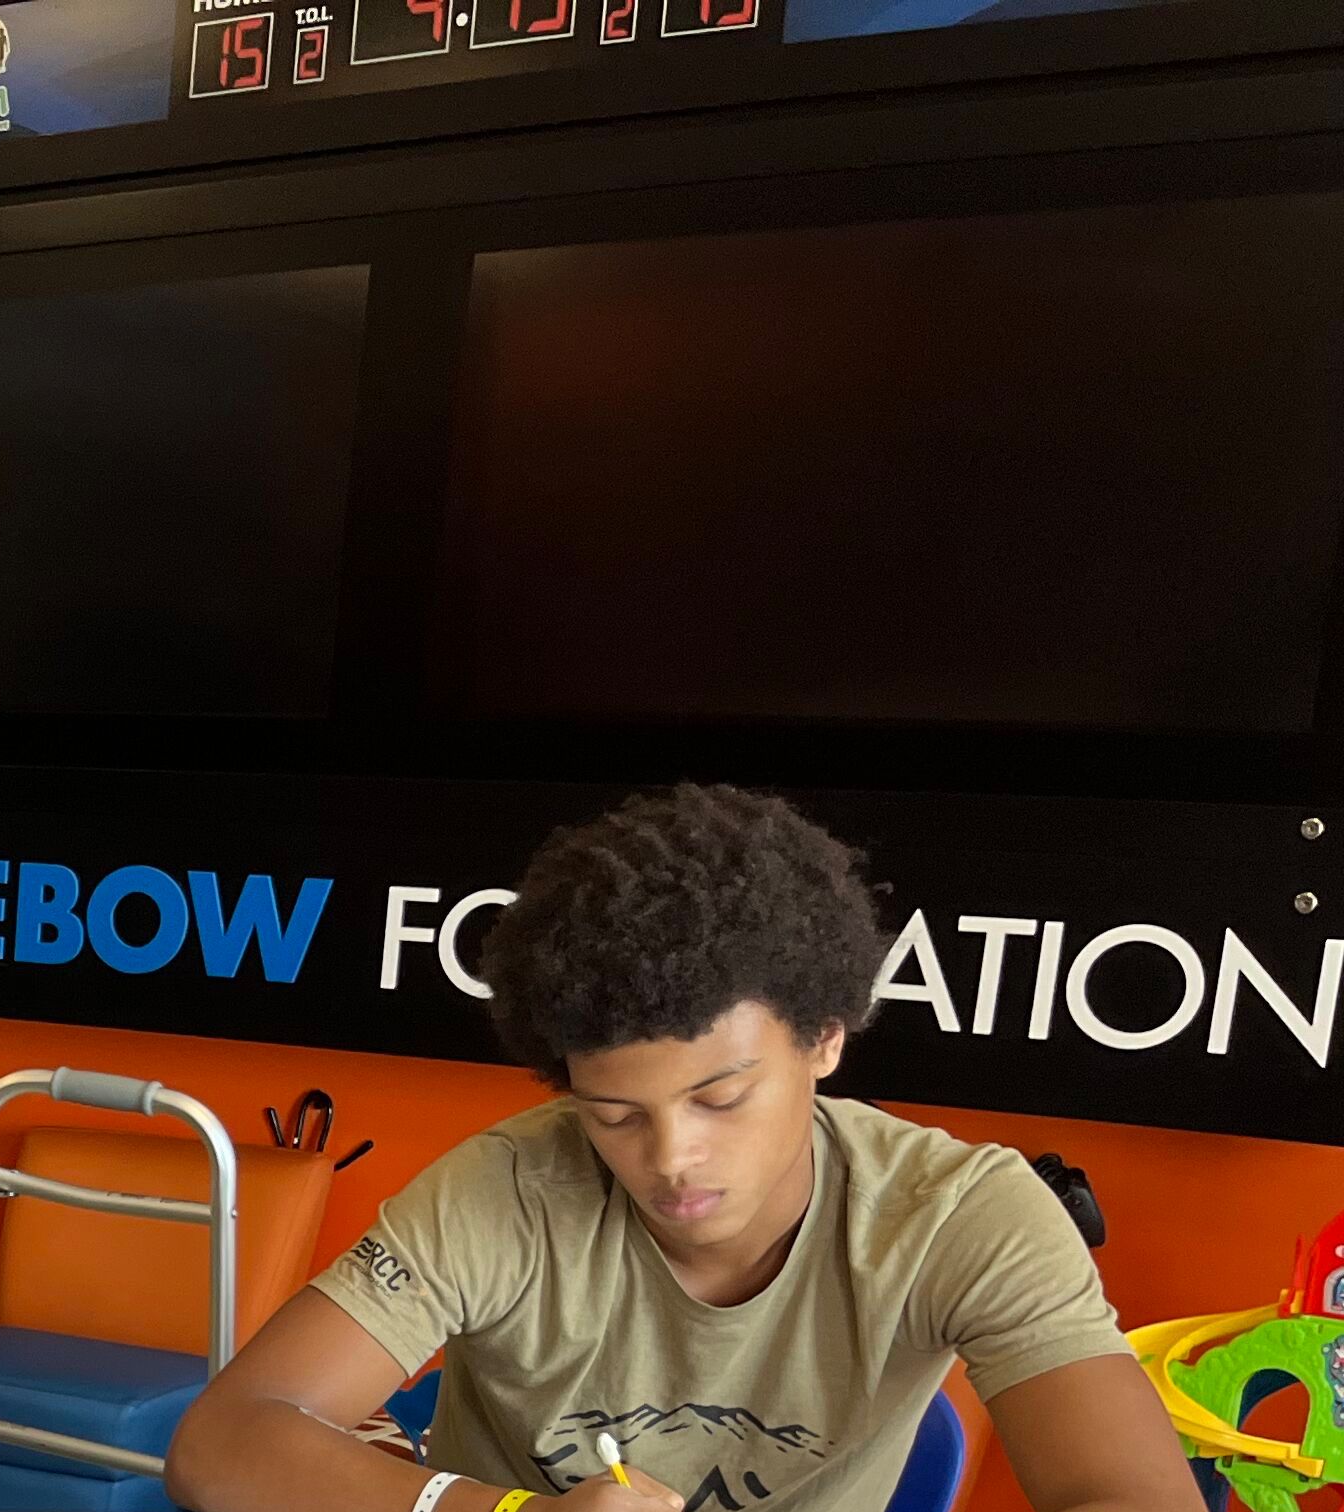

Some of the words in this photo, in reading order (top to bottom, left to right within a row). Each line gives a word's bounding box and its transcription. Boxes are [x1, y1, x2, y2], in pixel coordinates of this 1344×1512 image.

[295, 6, 334, 25] T.O.L.
[219, 19, 263, 88] 15
[298, 33, 324, 78] 2
[379, 885, 1344, 1069] FOATION
